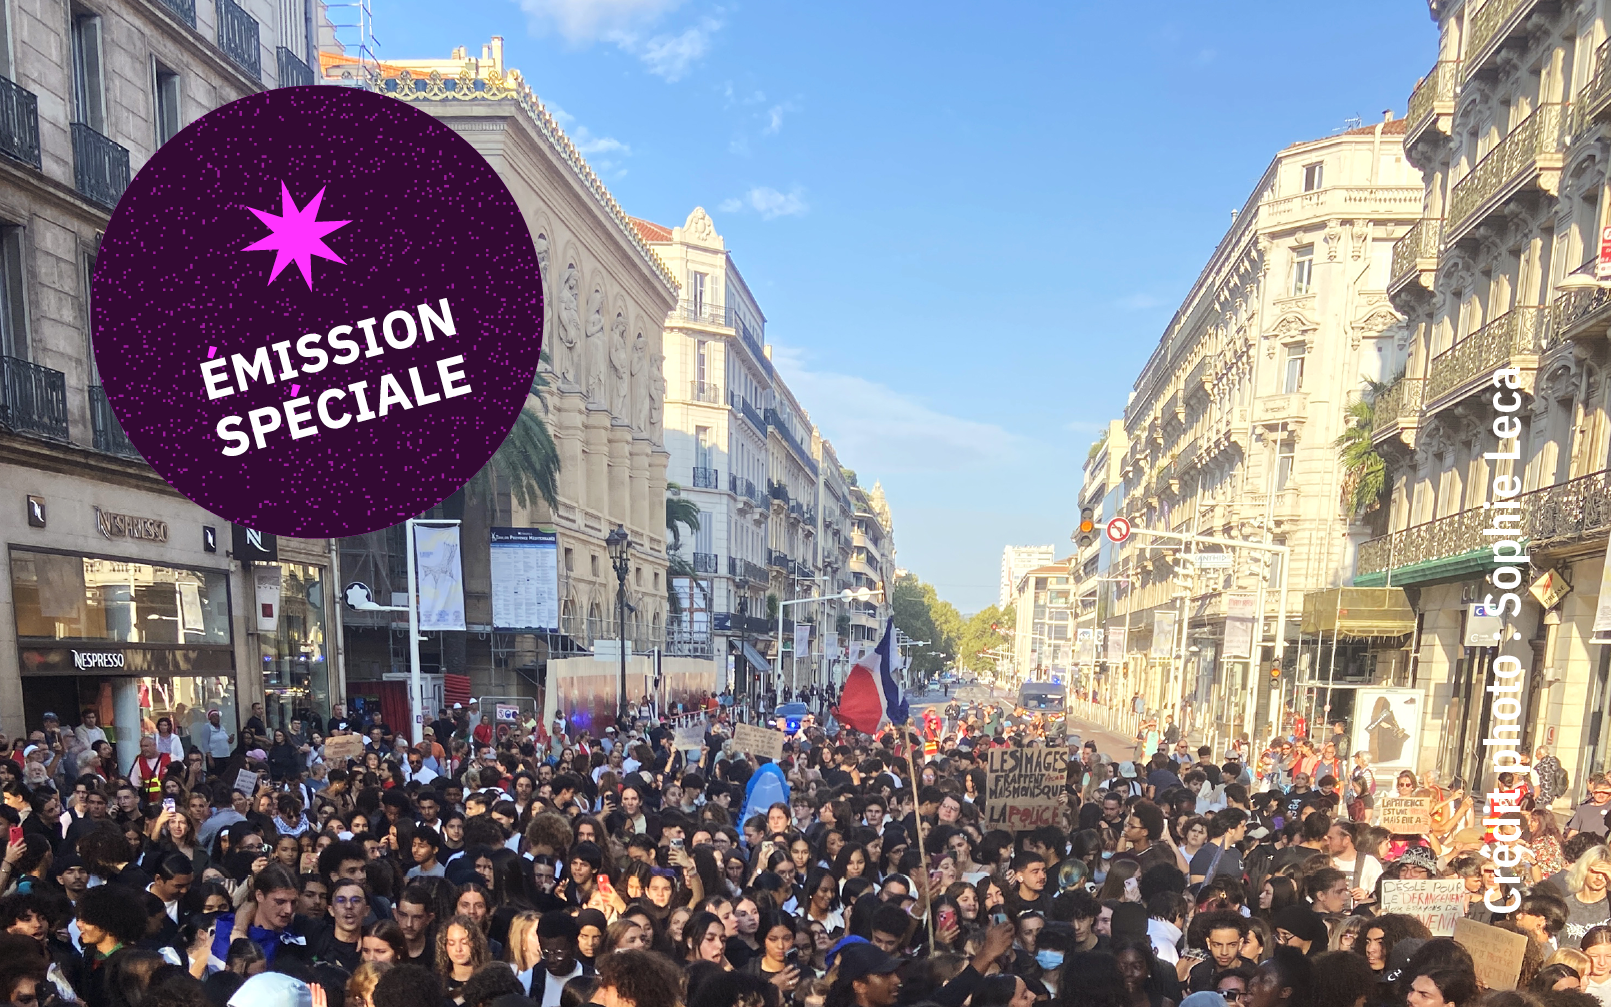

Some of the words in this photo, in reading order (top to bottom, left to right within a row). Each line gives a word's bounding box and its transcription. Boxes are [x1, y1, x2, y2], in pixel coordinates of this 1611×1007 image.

[93, 505, 169, 543] NESPRESSO
[1544, 584, 1566, 605] PRESSE
[71, 649, 125, 671] NESPRESSO
[989, 749, 1019, 773] LES
[1019, 747, 1068, 773] IMAGES
[994, 773, 1046, 787] FRAPPENT
[989, 785, 1012, 799] MAIS
[988, 802, 1007, 823] LA
[1008, 804, 1060, 826] POLICE
[1383, 816, 1401, 824] MAIS
[1414, 816, 1422, 824] A
[1383, 880, 1427, 894] DÉSOLÉ
[1433, 881, 1462, 893] POUR
[1383, 894, 1399, 905] LE
[1445, 904, 1458, 912] DE
